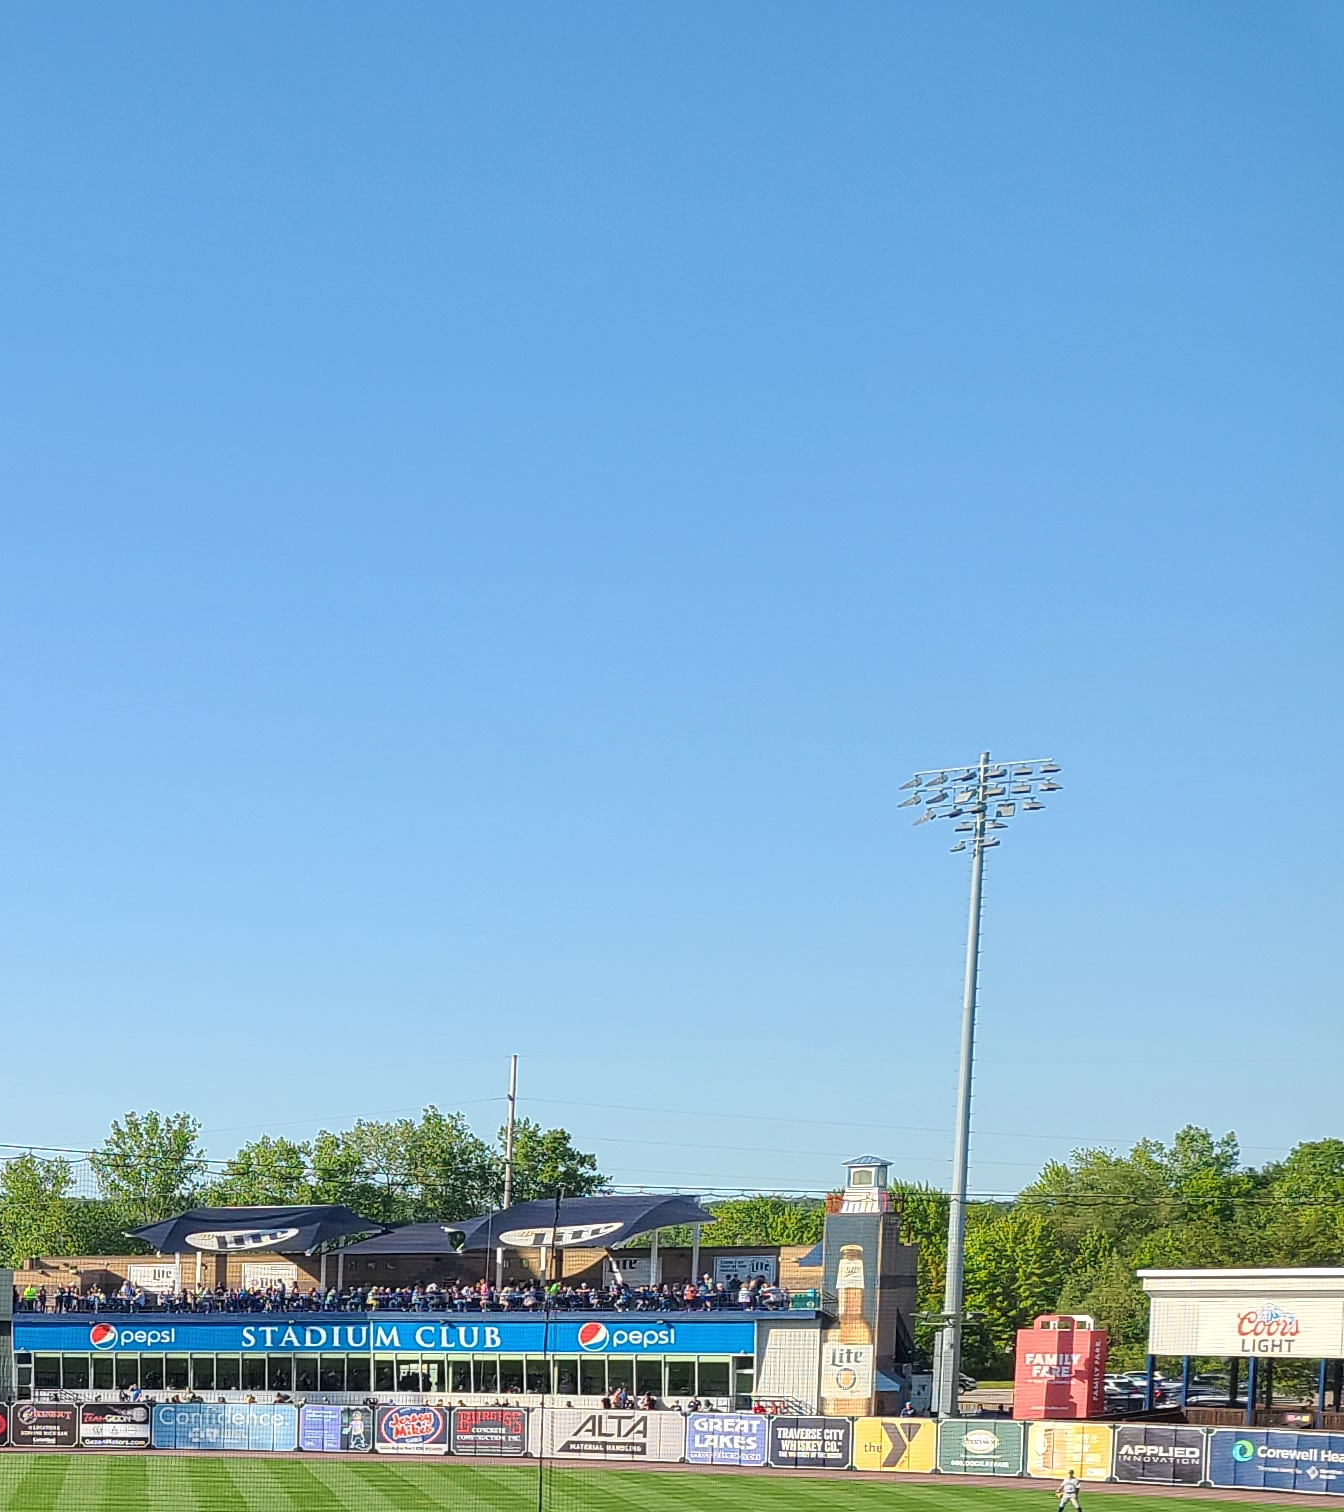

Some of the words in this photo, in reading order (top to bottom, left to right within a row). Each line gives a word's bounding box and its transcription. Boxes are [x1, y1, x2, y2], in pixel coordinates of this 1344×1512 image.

[1237, 1311, 1300, 1337] Coors
[121, 1328, 176, 1347] pepsi
[241, 1326, 402, 1347] STADIUM
[414, 1327, 502, 1349] CLUB
[612, 1328, 675, 1349] pepsi
[1241, 1339, 1296, 1353] LIGHT
[830, 1348, 863, 1367] Lite
[1025, 1353, 1081, 1366] FAMILY
[389, 1412, 434, 1428] Jersey
[573, 1414, 648, 1439] ALTA
[694, 1417, 761, 1432] GREAT
[776, 1427, 824, 1440] TRAVERSE
[824, 1428, 845, 1440] CITY
[569, 1443, 604, 1452] MATERIAL
[694, 1435, 758, 1450] LAKES
[781, 1439, 824, 1452] WHISKEY
[864, 1442, 883, 1453] the
[881, 1422, 922, 1468] Y
[1118, 1444, 1200, 1458] APPLIED
[1257, 1446, 1318, 1461] Corewell
[1118, 1455, 1200, 1465] INNOVATION
